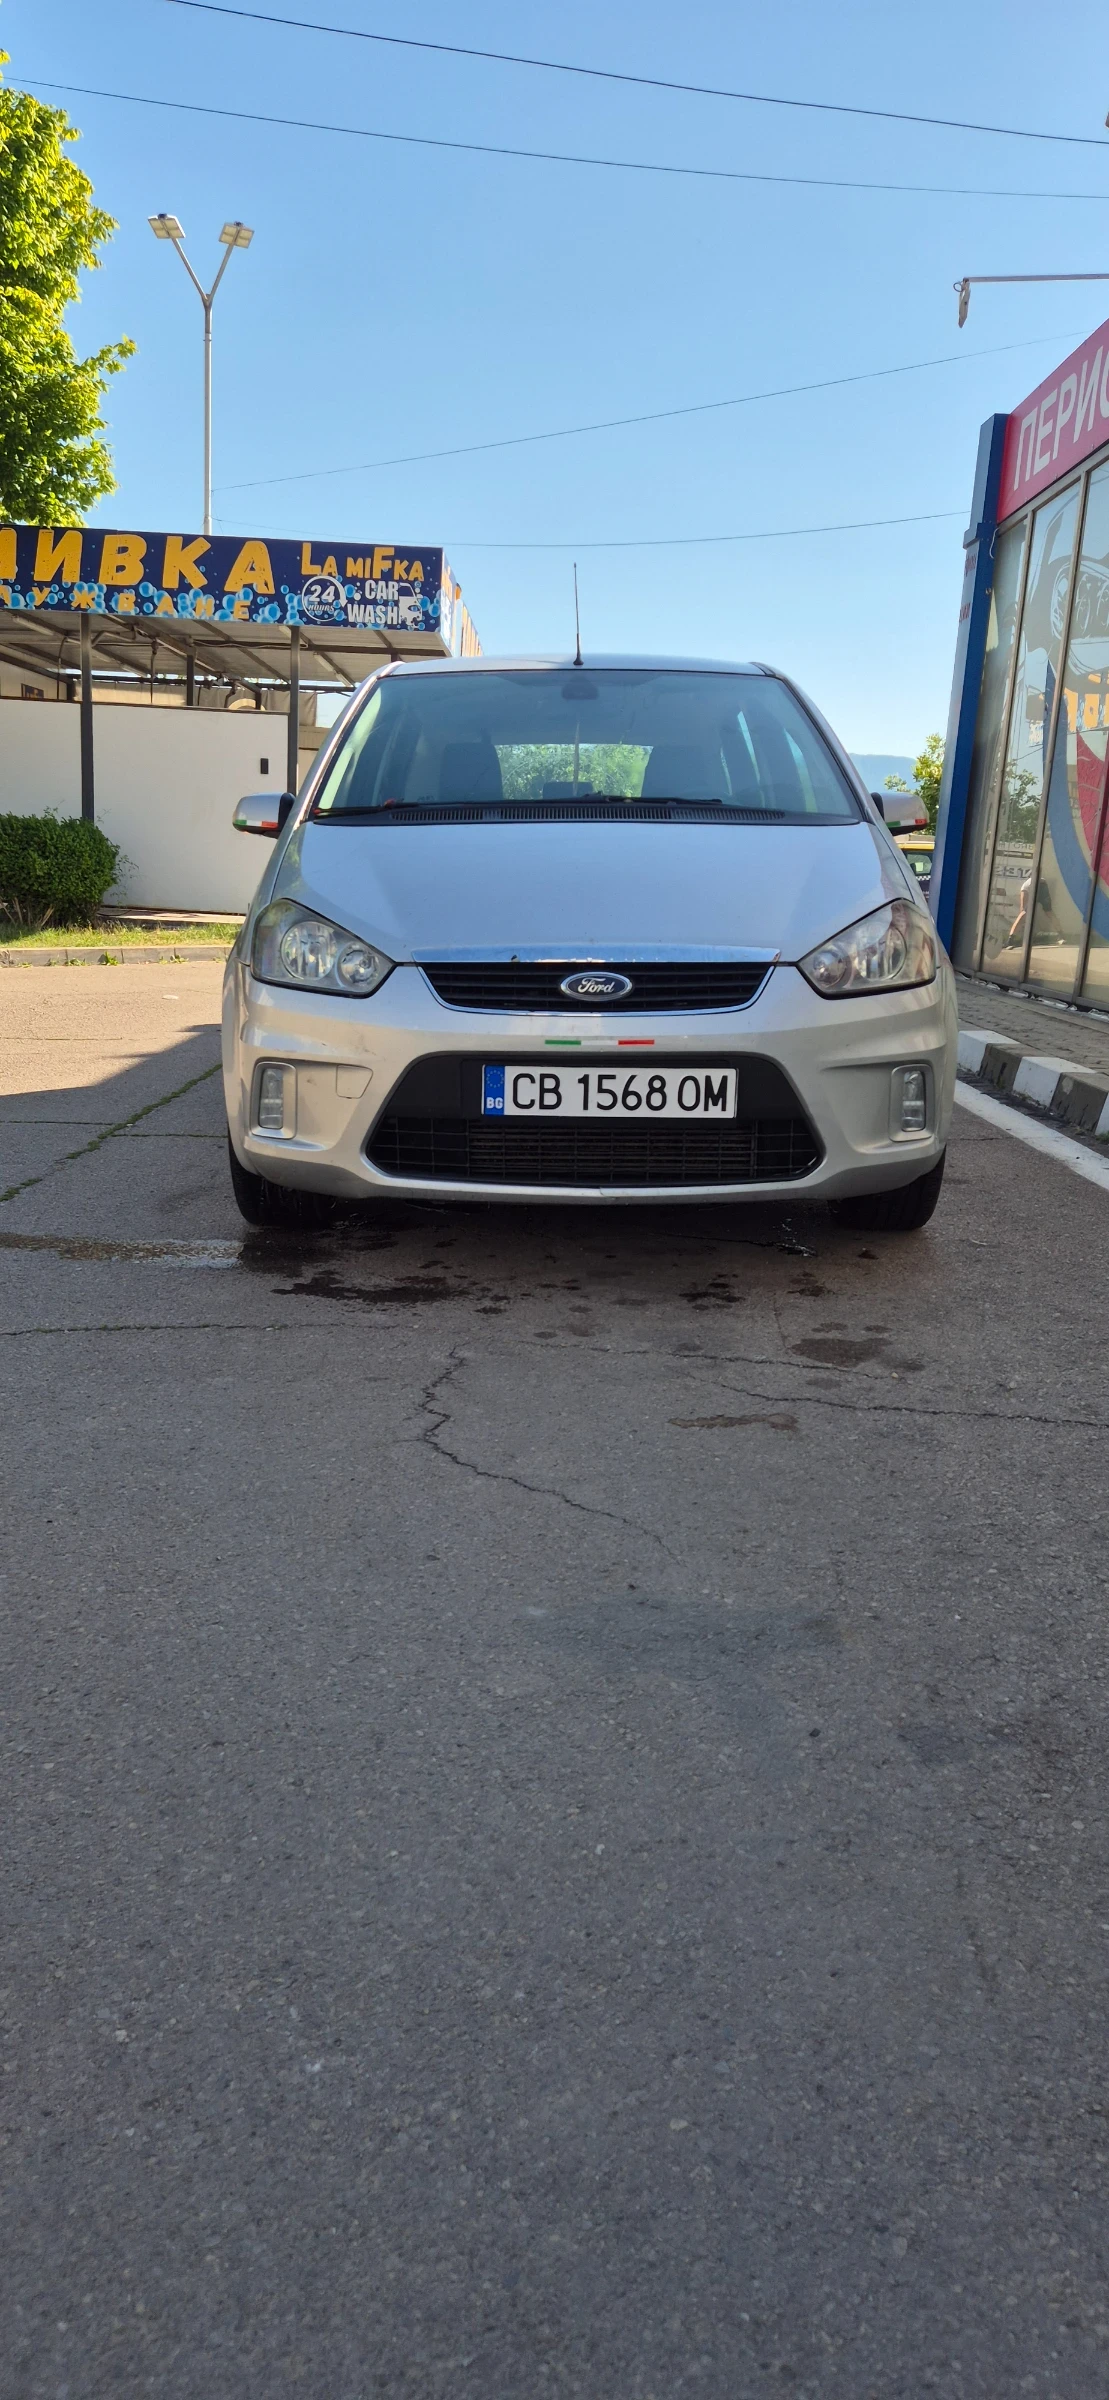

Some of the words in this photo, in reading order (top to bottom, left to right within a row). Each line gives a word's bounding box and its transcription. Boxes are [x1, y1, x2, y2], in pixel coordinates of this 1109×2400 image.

[301, 542, 338, 576] LA
[309, 584, 335, 603] 24
[365, 579, 399, 600] CAR
[308, 603, 335, 613] HOURS
[347, 603, 400, 625] WASH
[577, 977, 615, 993] Ford
[512, 1072, 562, 1110] CB
[577, 1073, 667, 1112] 1568
[677, 1075, 728, 1112] OM
[486, 1097, 503, 1109] BG
